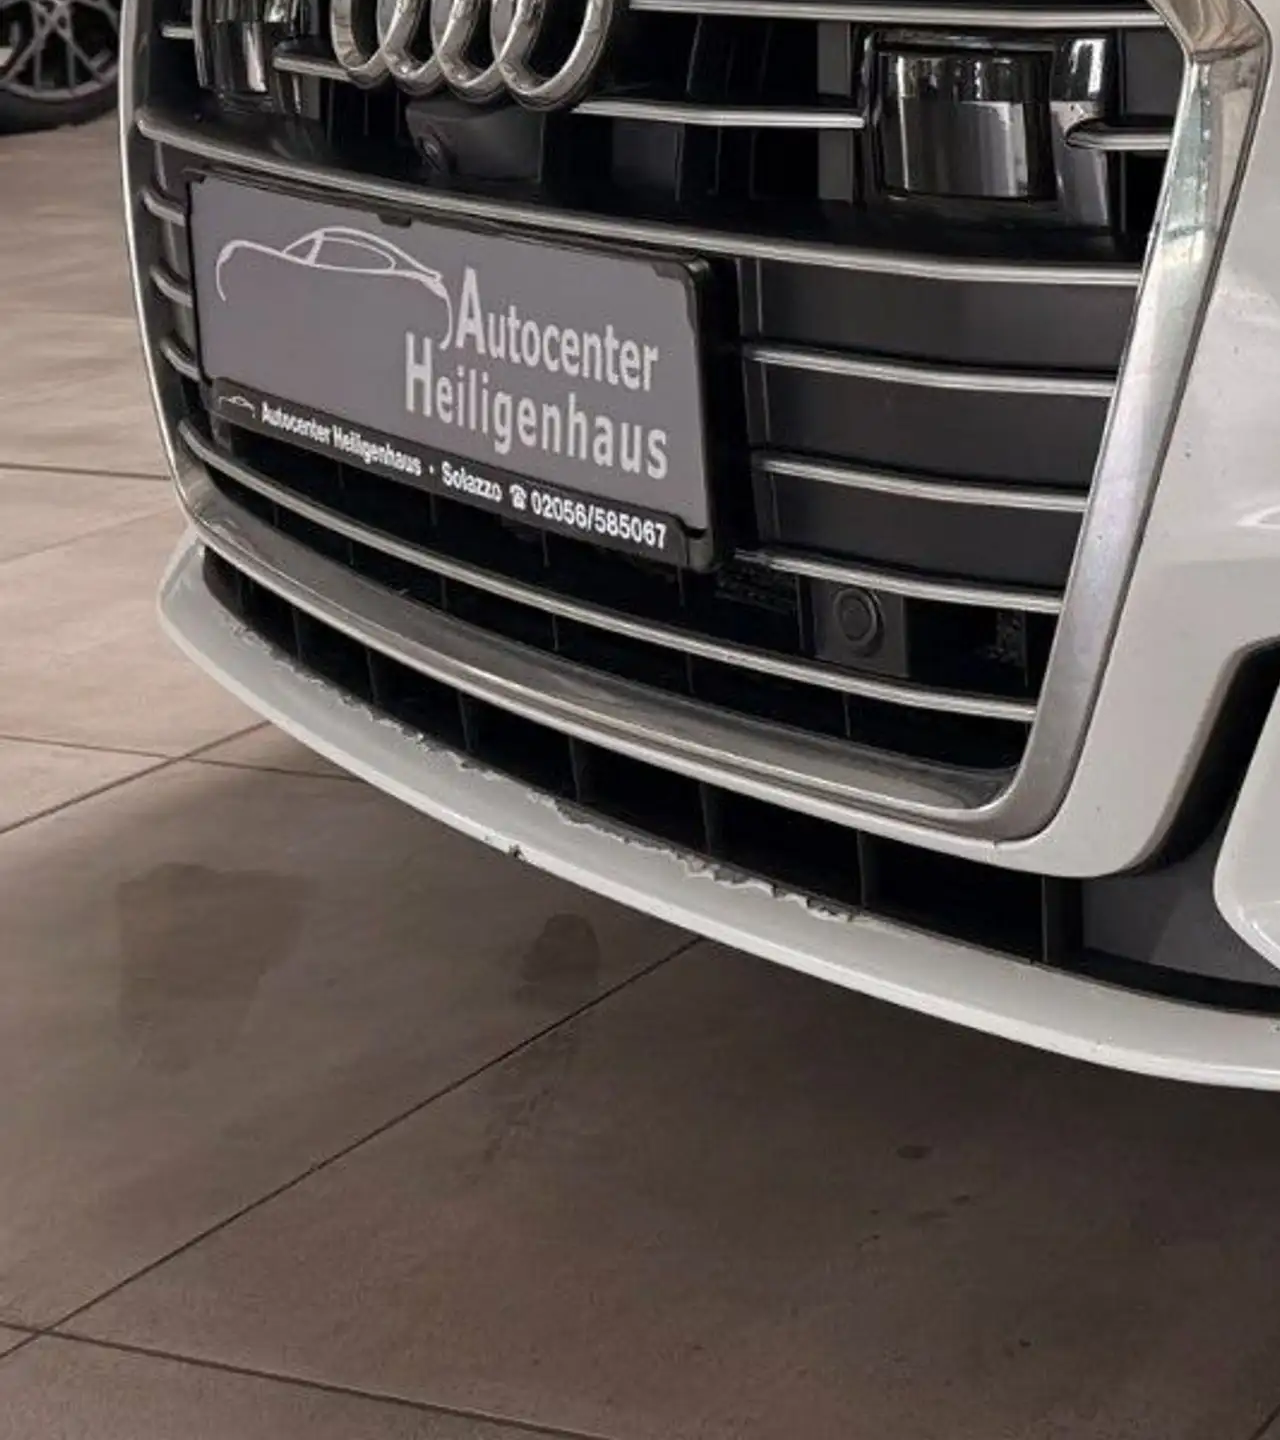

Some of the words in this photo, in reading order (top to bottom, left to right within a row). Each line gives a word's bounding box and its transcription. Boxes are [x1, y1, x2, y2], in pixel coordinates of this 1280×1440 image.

[455, 266, 659, 392] Autocenter
[261, 401, 331, 445] Autocenter
[331, 424, 422, 476] Heiligenhaus
[441, 460, 503, 502] Solazzo
[530, 489, 668, 549] 02056/585067
[404, 331, 668, 479] Heiligenhaus
